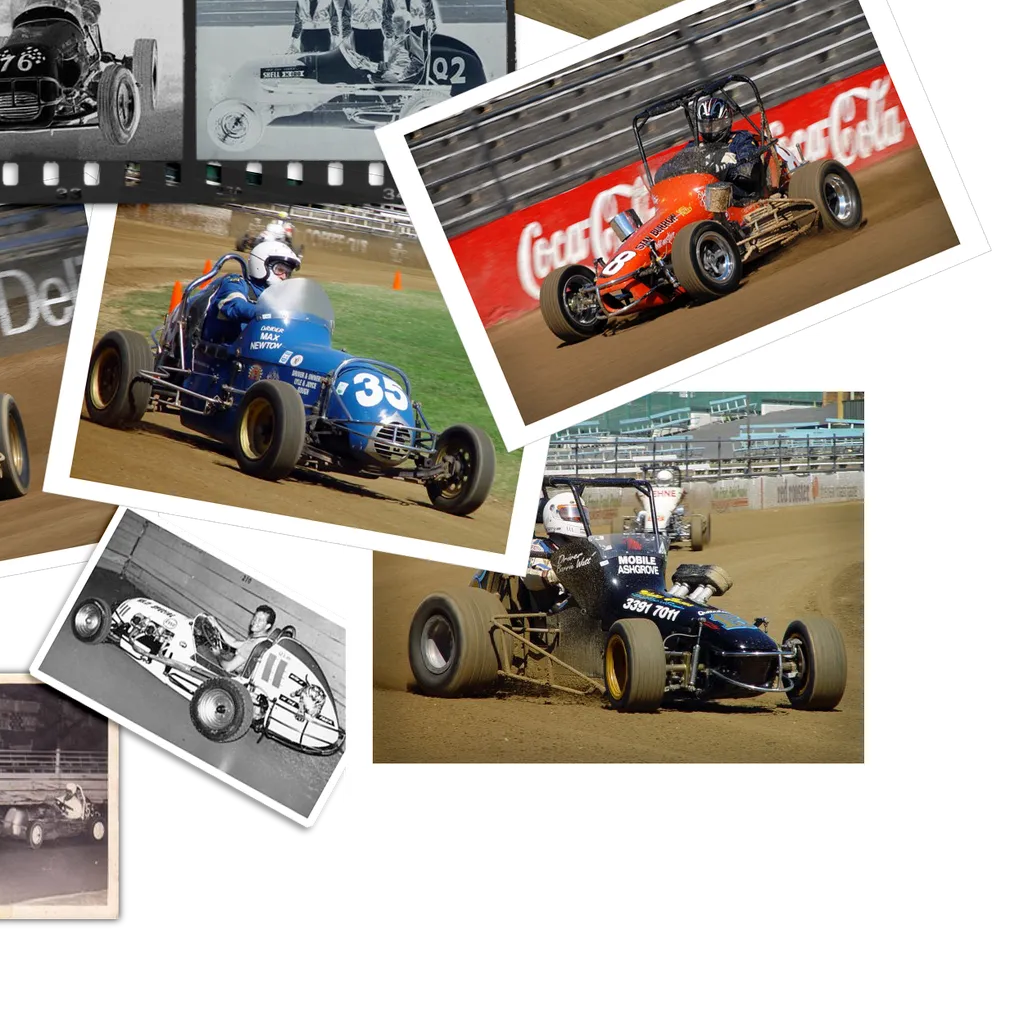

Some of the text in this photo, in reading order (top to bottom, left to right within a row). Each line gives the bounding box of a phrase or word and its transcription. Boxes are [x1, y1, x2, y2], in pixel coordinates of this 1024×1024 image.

[0, 54, 33, 72] 76
[432, 56, 466, 85] Q2
[601, 250, 637, 276] 8
[250, 342, 282, 350] NEWTON
[260, 332, 280, 341] MAX
[353, 372, 408, 412] 35
[617, 565, 660, 575] ASHGROVE
[618, 555, 657, 566] MOBILE
[622, 597, 681, 622] 3391 7011
[261, 652, 288, 689] 11
